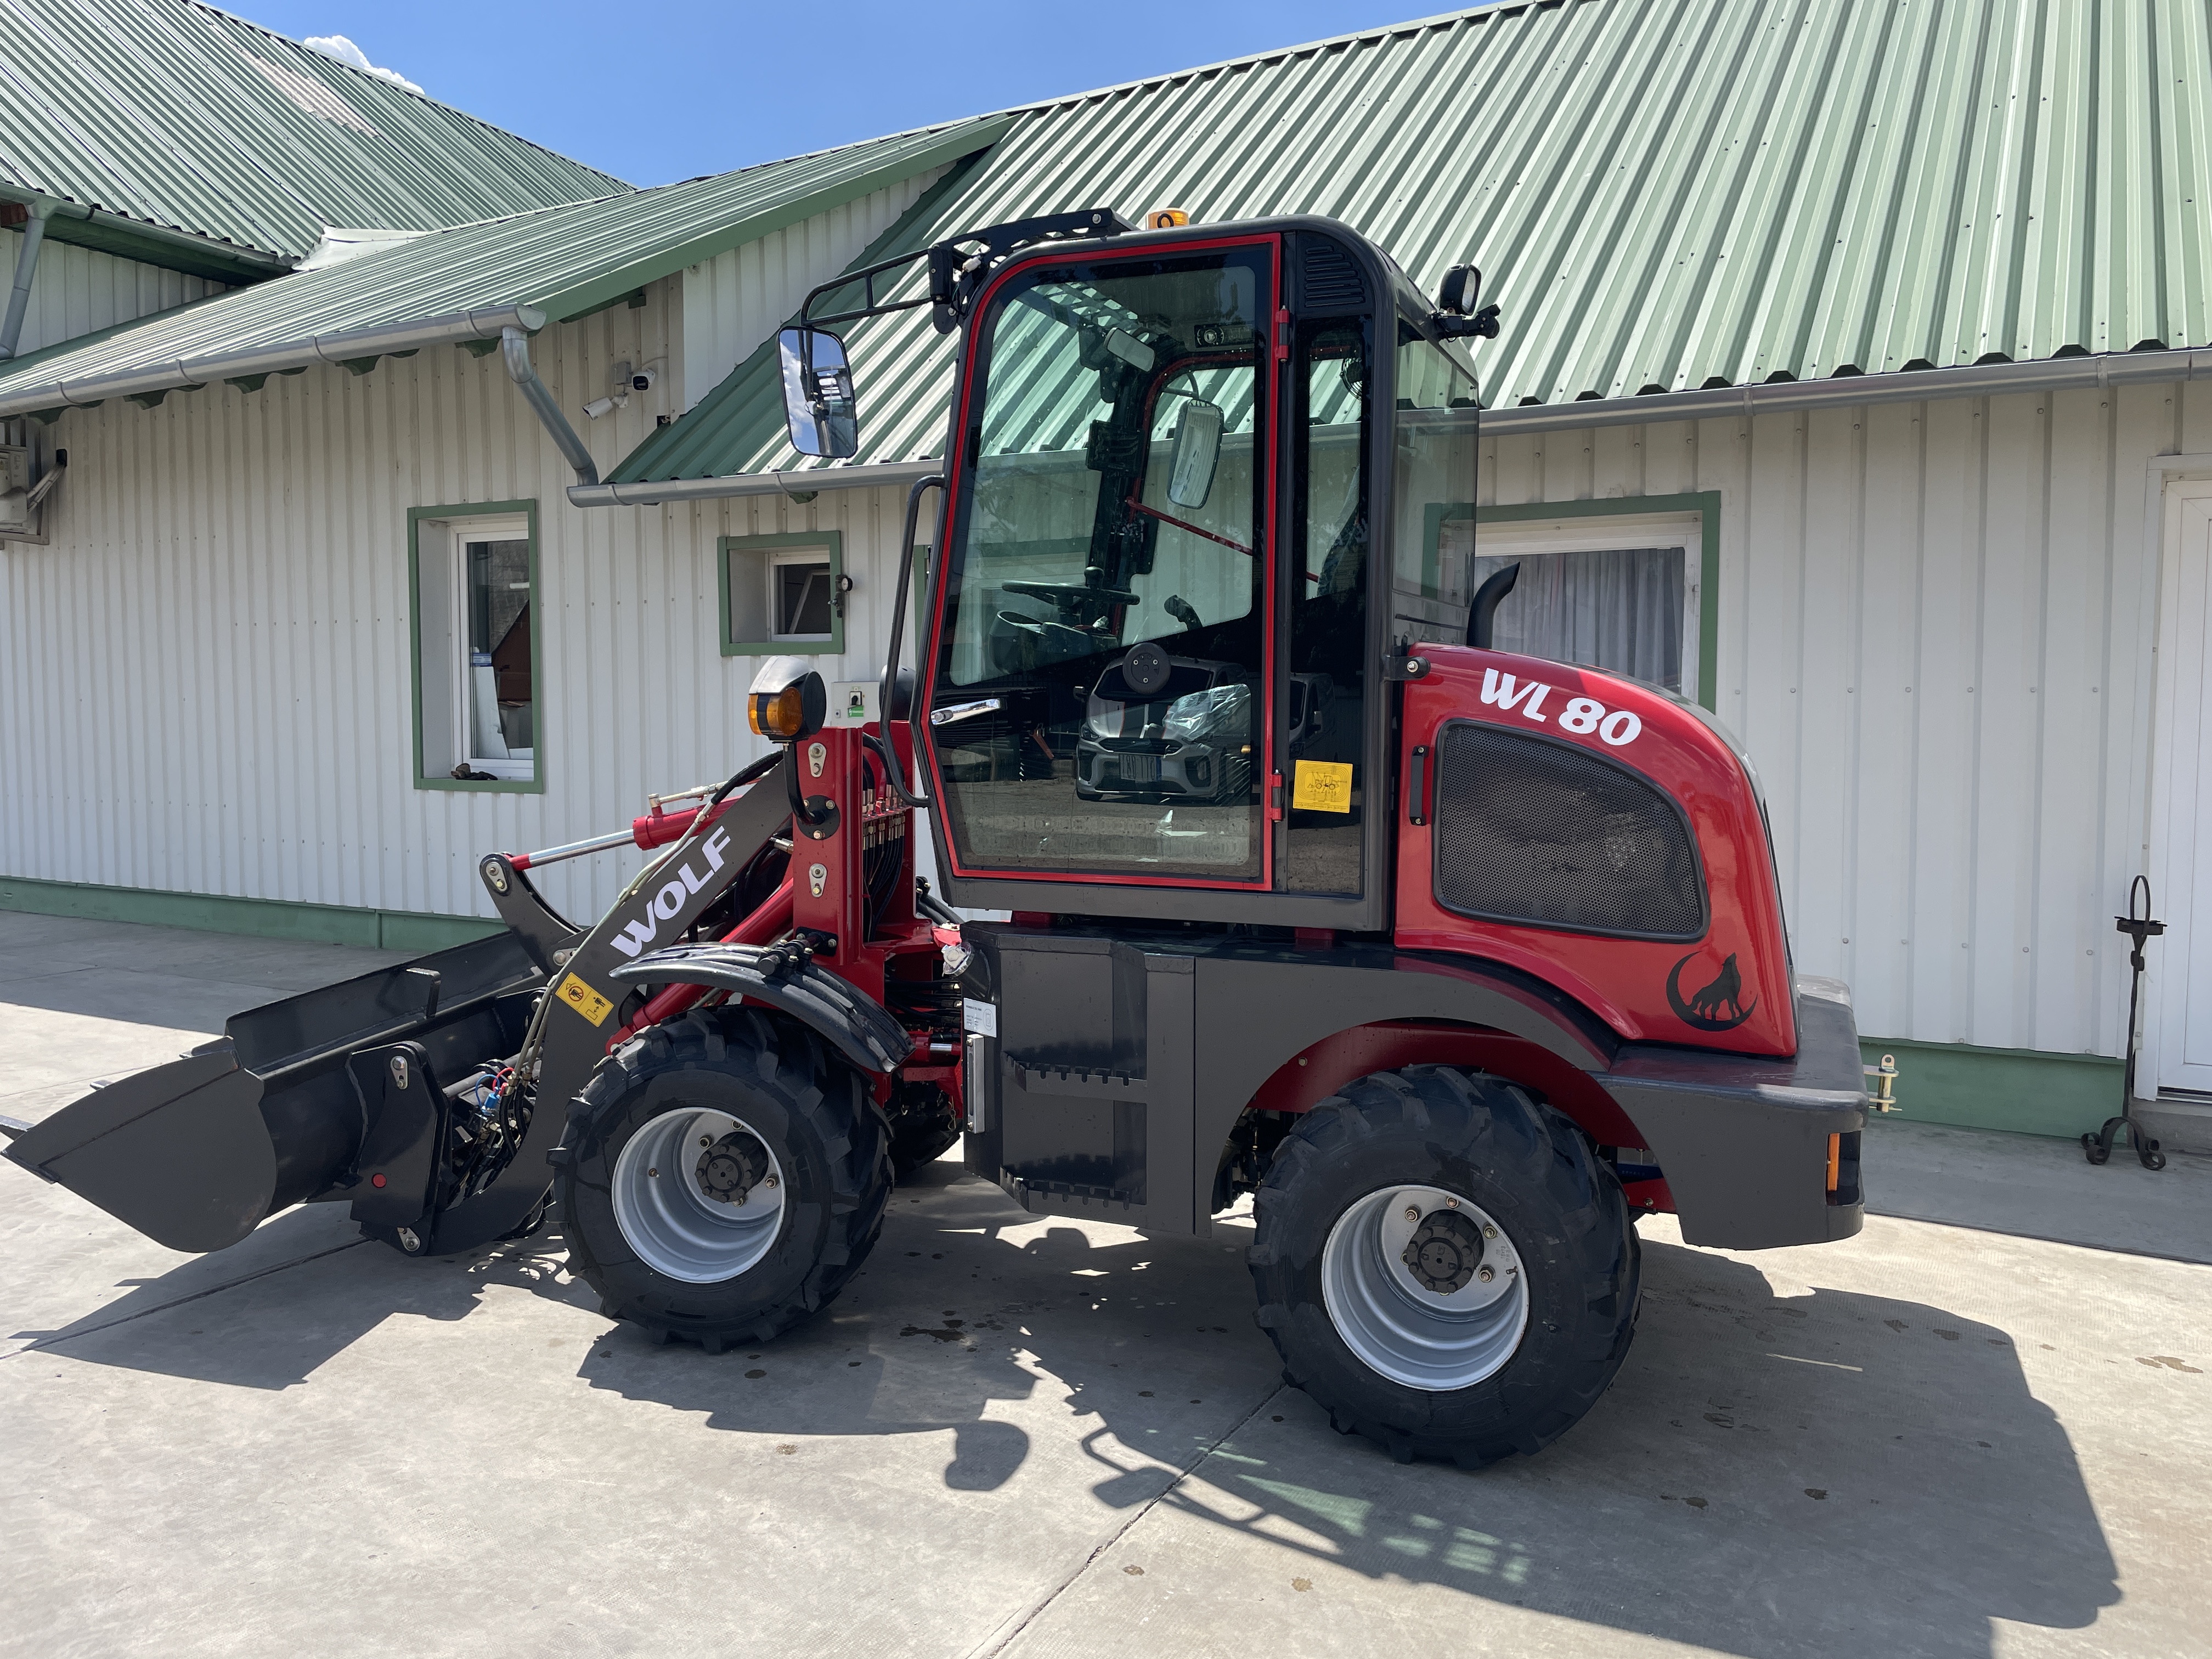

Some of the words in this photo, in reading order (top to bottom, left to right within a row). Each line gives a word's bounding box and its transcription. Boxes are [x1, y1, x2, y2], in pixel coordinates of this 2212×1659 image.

[1481, 668, 1551, 723] WL
[1559, 698, 1641, 746] 80
[610, 826, 730, 957] WOLF
